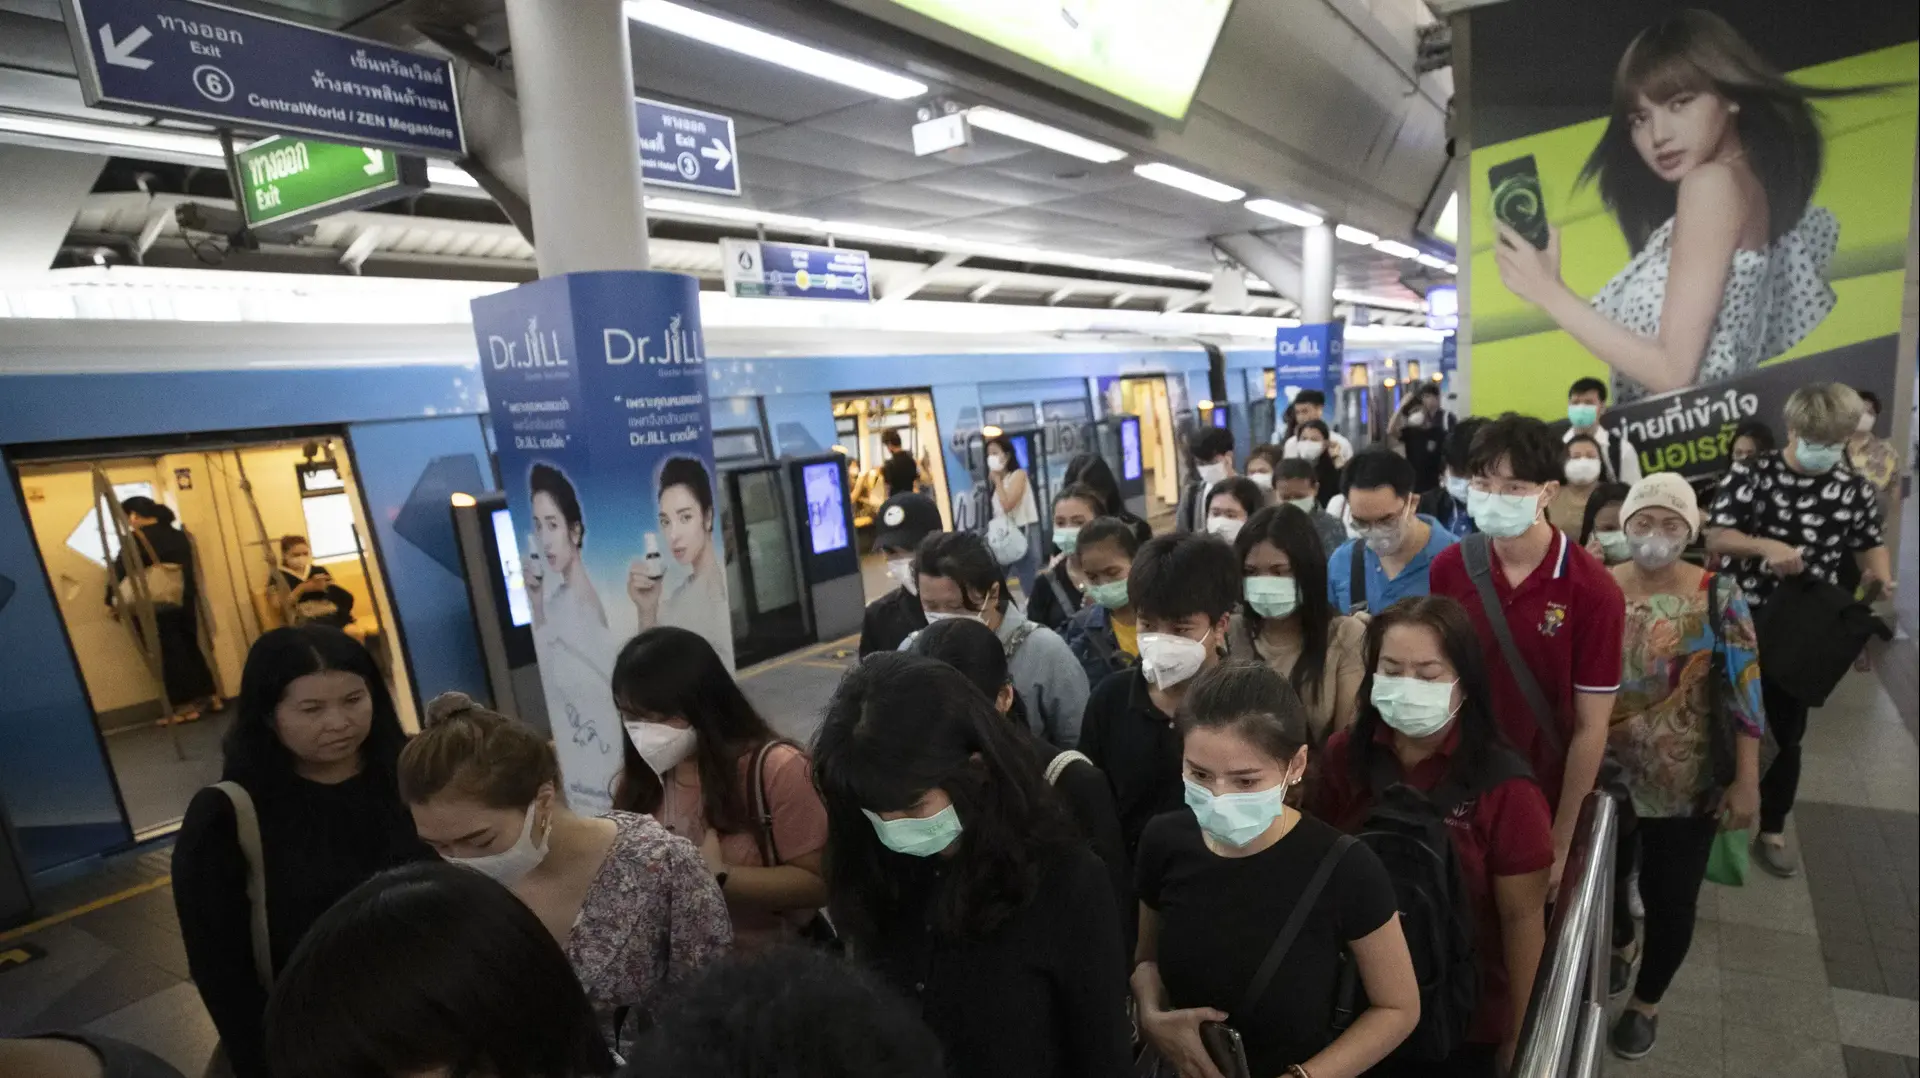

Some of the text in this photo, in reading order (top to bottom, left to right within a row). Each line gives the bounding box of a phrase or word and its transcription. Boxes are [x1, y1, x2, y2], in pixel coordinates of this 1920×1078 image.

[157, 14, 243, 45] ทางออก
[190, 40, 221, 58] Exit
[248, 93, 346, 121] CentralWorld
[357, 111, 386, 128] ZEN
[388, 116, 454, 139] Megastore
[249, 142, 310, 187] ทางออก
[255, 184, 281, 211] Exit
